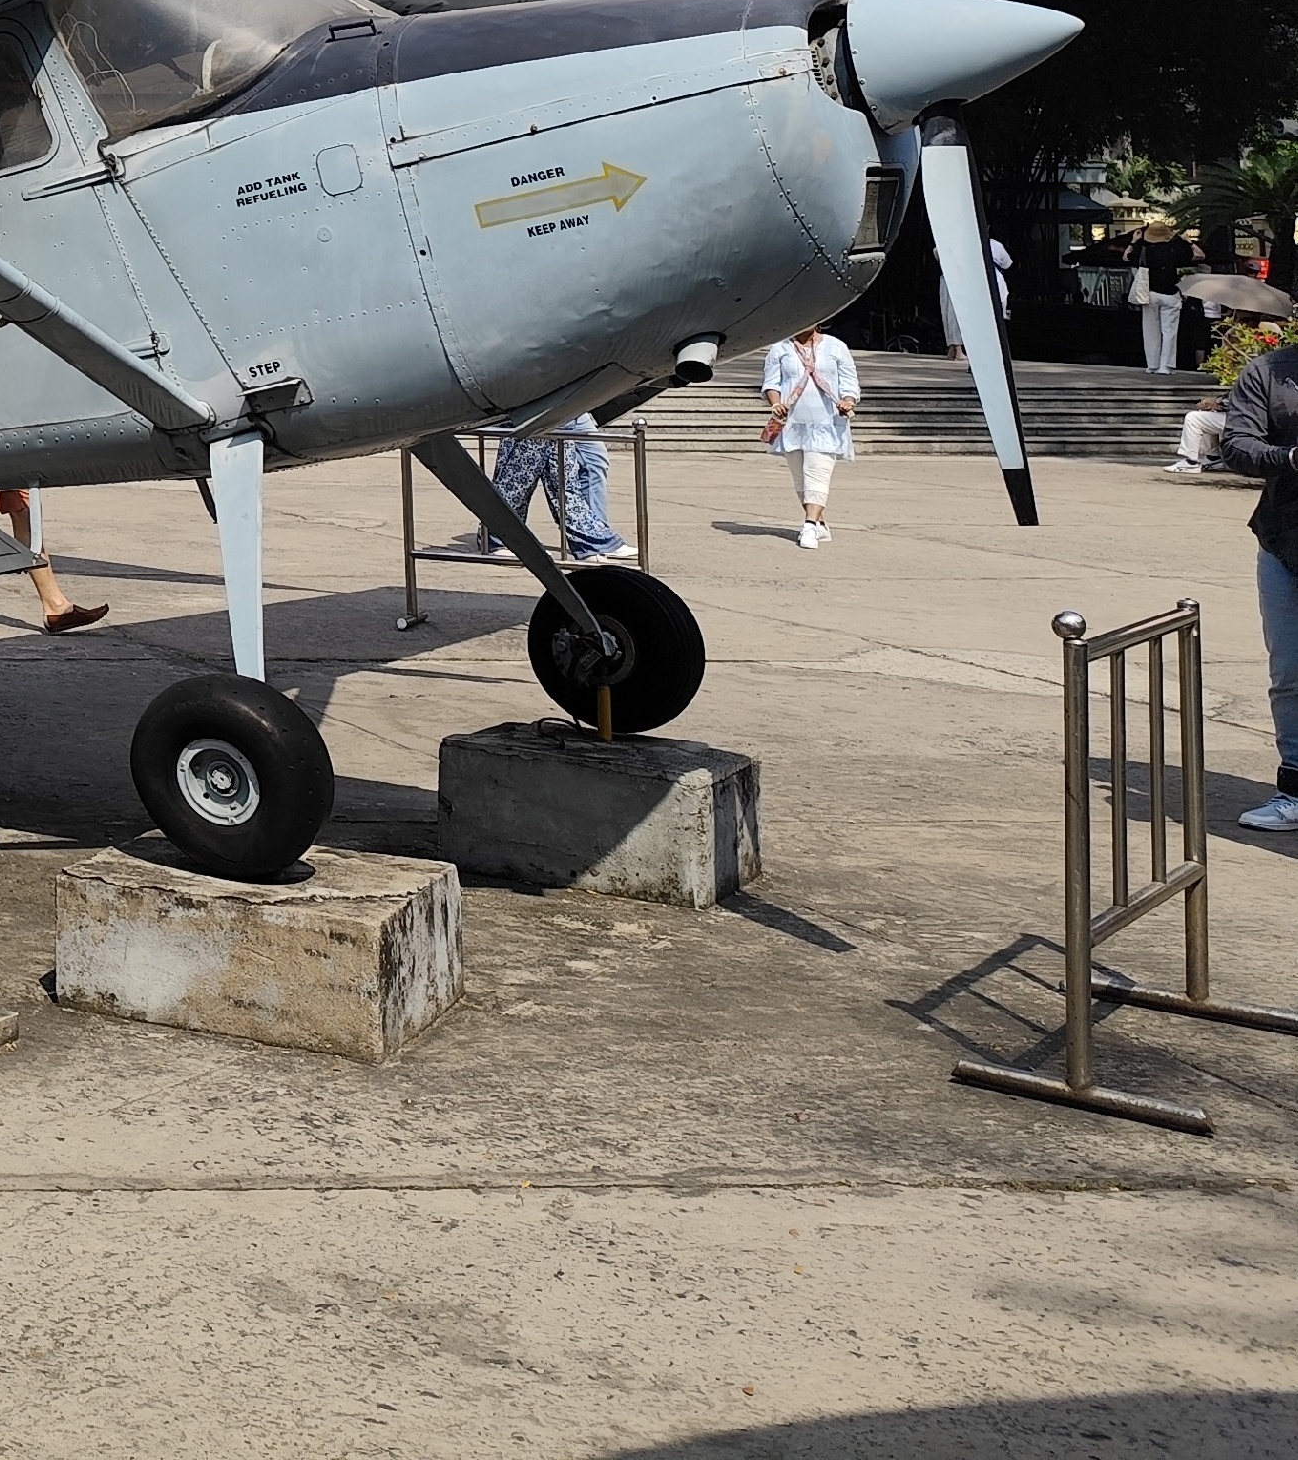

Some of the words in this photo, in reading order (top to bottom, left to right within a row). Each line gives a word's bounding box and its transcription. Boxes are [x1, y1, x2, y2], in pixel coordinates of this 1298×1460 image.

[237, 181, 263, 196] ADD
[265, 171, 301, 188] TANK
[510, 166, 566, 188] DANGER
[235, 182, 308, 208] REFUELING
[526, 222, 557, 238] KEEP
[559, 214, 590, 231] AWAY
[248, 361, 281, 378] STEP
